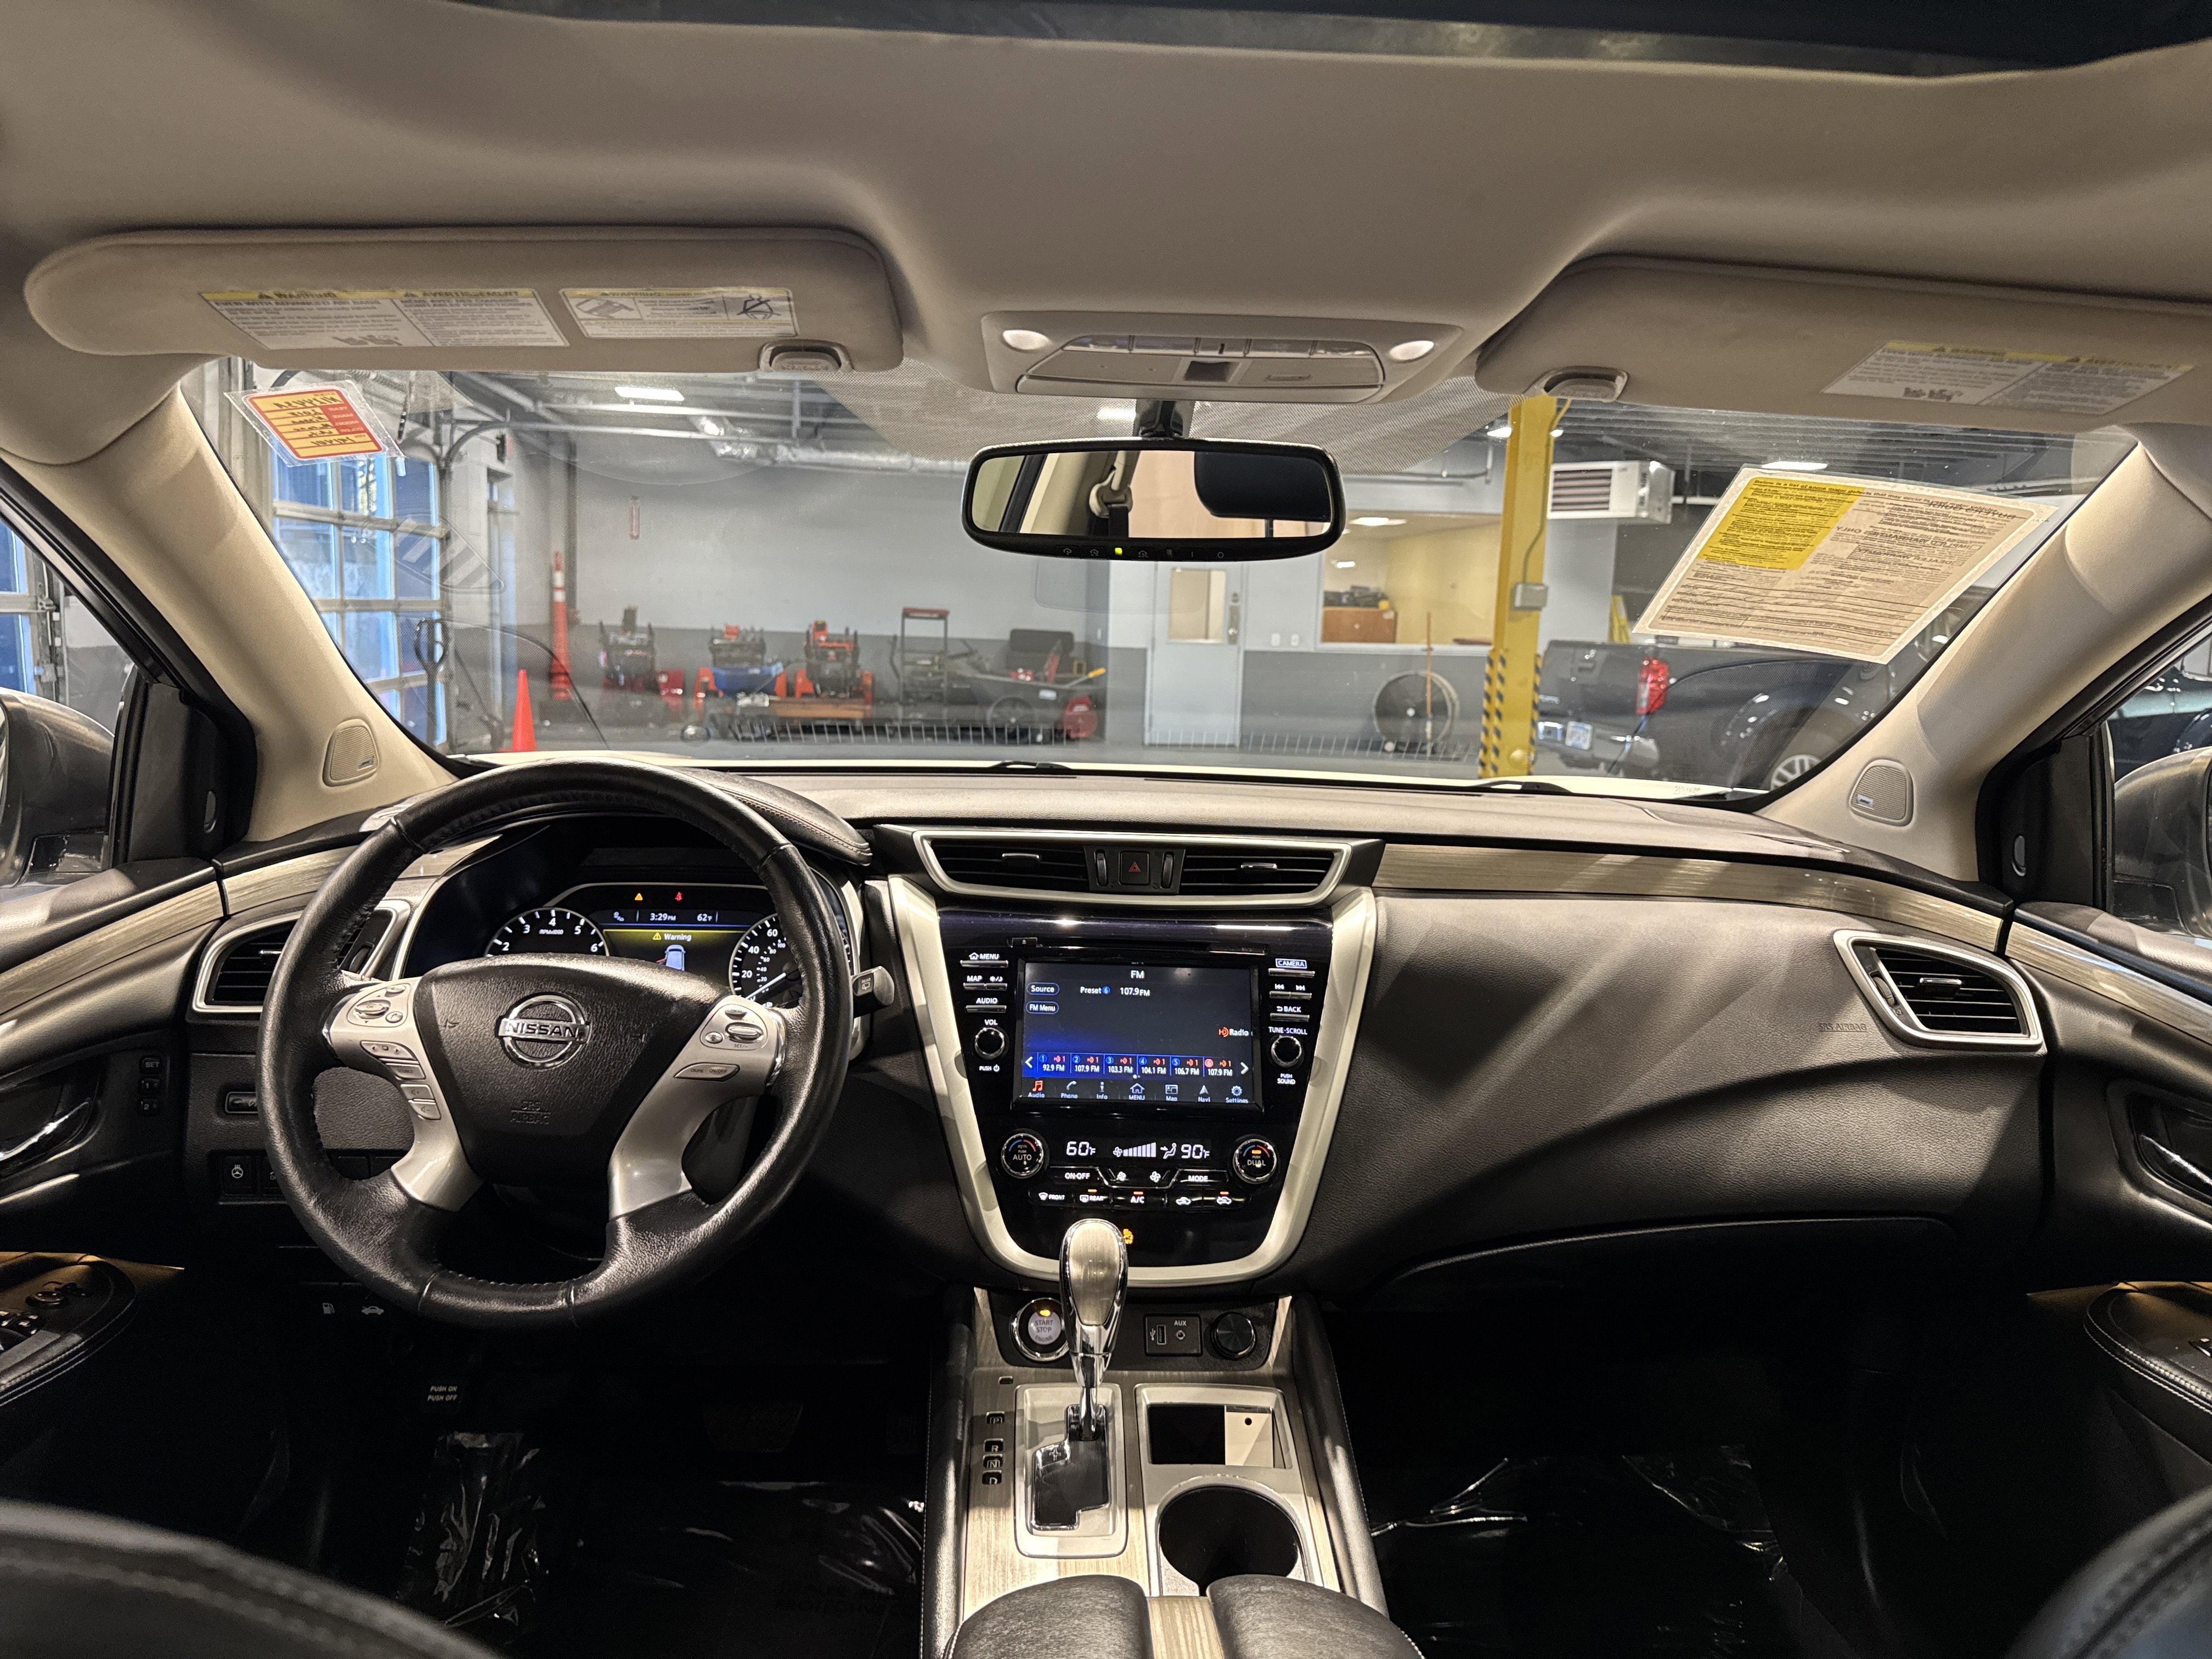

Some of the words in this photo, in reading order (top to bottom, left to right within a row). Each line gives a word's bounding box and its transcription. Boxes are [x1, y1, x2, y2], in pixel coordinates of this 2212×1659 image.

[548, 917, 556, 926] 4
[522, 924, 531, 934] 3
[574, 925, 582, 935] 5
[766, 928, 778, 937] 60
[664, 933, 692, 942] Warning
[501, 941, 510, 951] 2
[590, 943, 598, 952] 6
[748, 945, 760, 954] 40
[741, 969, 753, 978] 20
[1131, 970, 1145, 979] FM
[1031, 985, 1055, 993] Source
[1080, 986, 1102, 994] Preset
[1039, 1004, 1056, 1012] Menu
[505, 1022, 579, 1039] NISSAN
[1818, 1023, 1833, 1031] SRS
[1836, 1023, 1868, 1031] AIRBAG
[1229, 1028, 1249, 1036] Radio
[1207, 1068, 1222, 1076] 107.9
[1130, 1195, 1145, 1204] A/C
